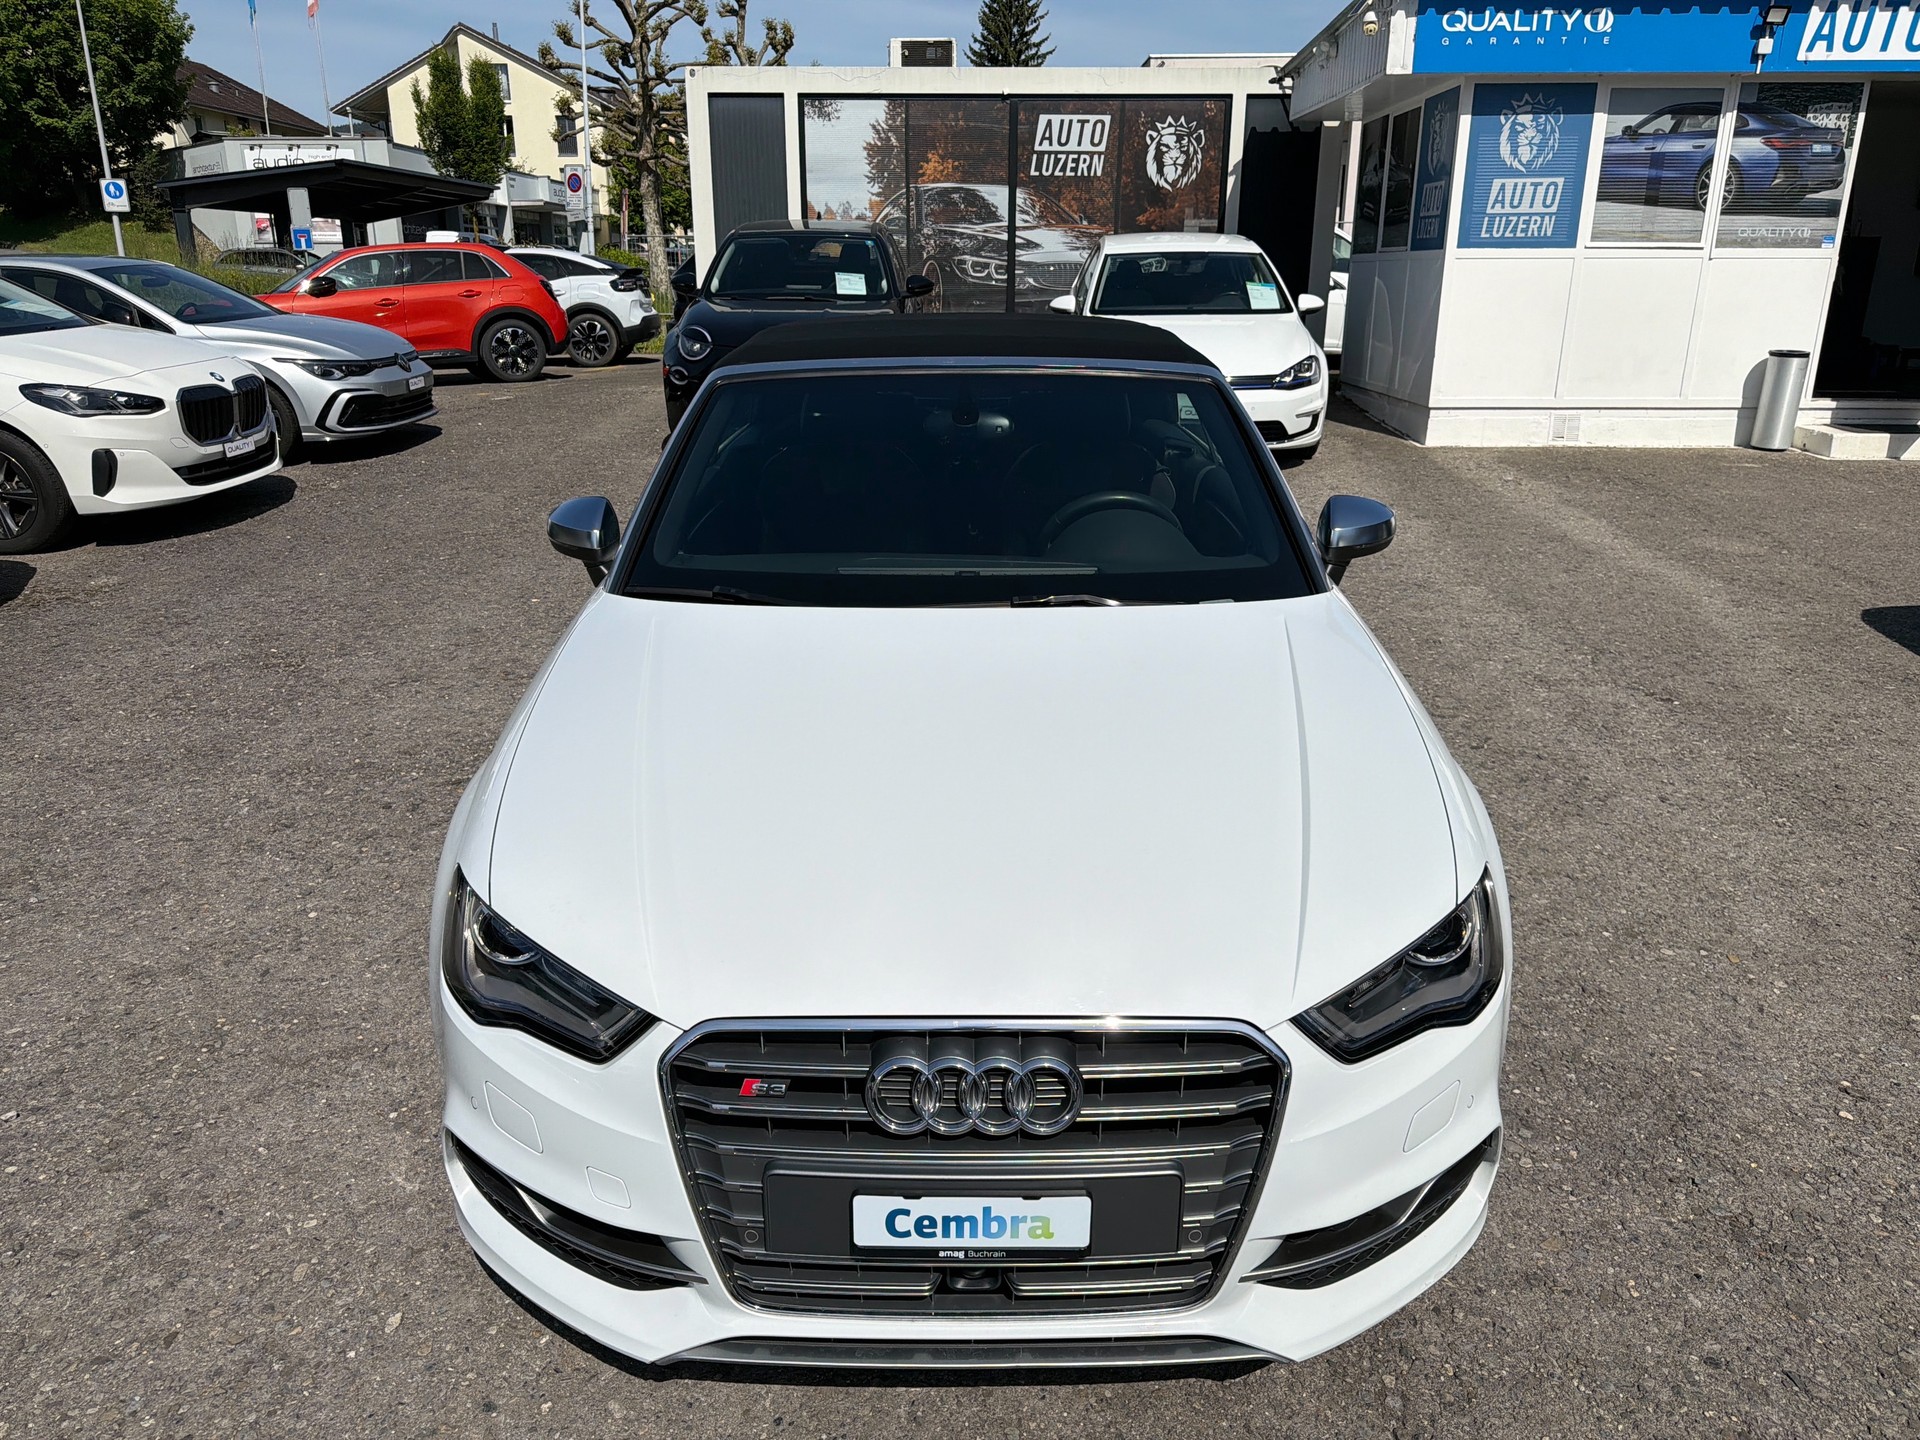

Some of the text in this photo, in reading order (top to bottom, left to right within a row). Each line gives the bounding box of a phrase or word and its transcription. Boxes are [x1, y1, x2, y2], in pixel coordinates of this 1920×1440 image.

[1442, 9, 1582, 32] QUALITY
[1441, 36, 1611, 46] GARANTIE
[1038, 118, 1106, 148] AUTO
[1030, 153, 1105, 177] LUZERN
[1421, 184, 1443, 212] AUTO
[1490, 181, 1559, 210] AUTO
[1416, 217, 1440, 239] LUZERN
[1480, 215, 1556, 238] LUZERN
[1738, 227, 1798, 237] QUALITY
[227, 442, 250, 454] QUALITY
[884, 1206, 1055, 1240] Cembra
[938, 1250, 1007, 1259] amag Buchrain
